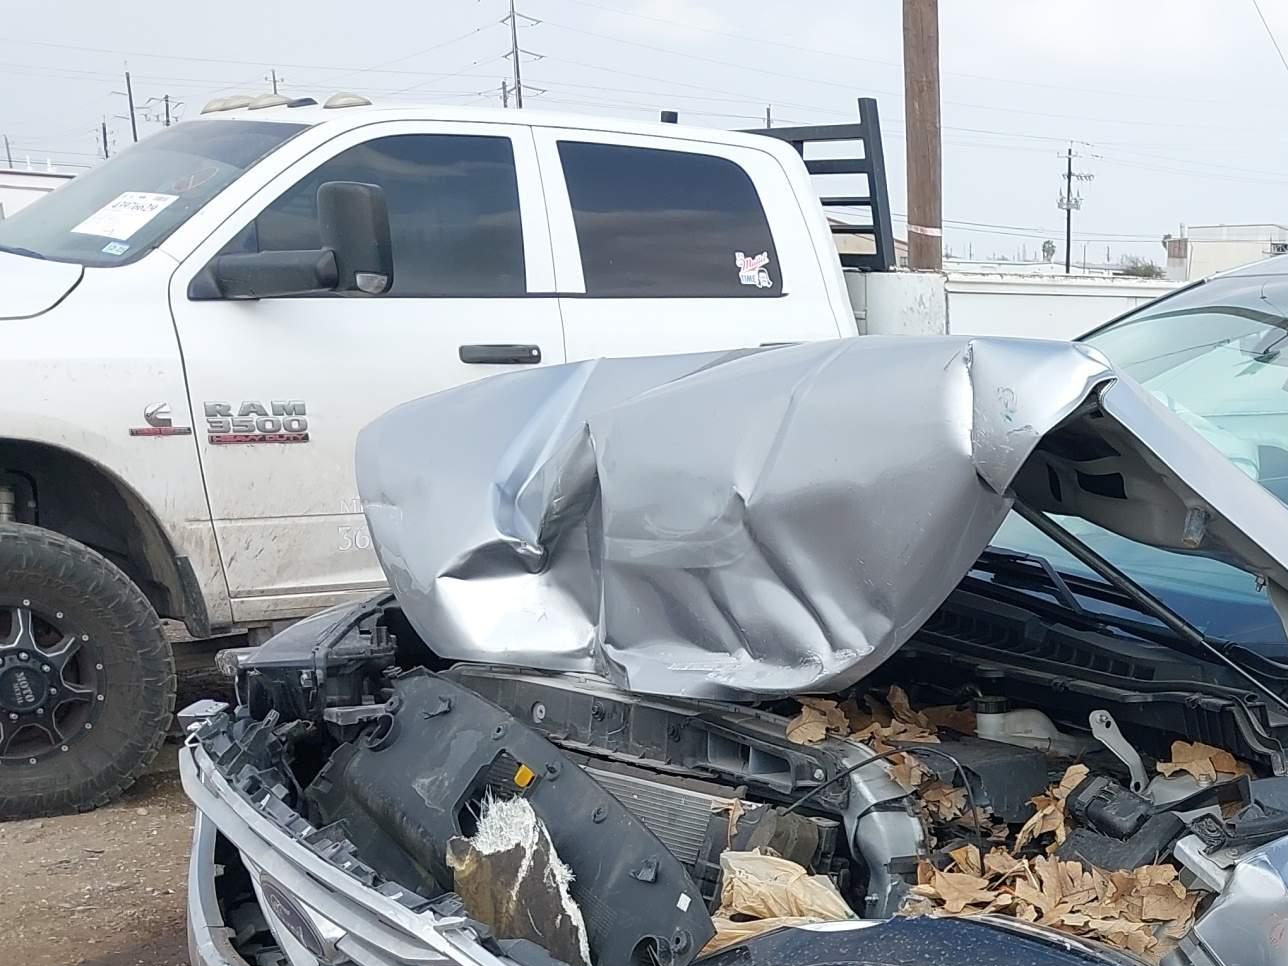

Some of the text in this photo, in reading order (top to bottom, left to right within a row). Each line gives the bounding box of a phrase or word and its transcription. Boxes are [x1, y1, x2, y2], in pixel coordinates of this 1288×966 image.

[203, 400, 307, 417] RAM
[207, 417, 308, 433] 3500
[262, 434, 305, 443] DUTY
